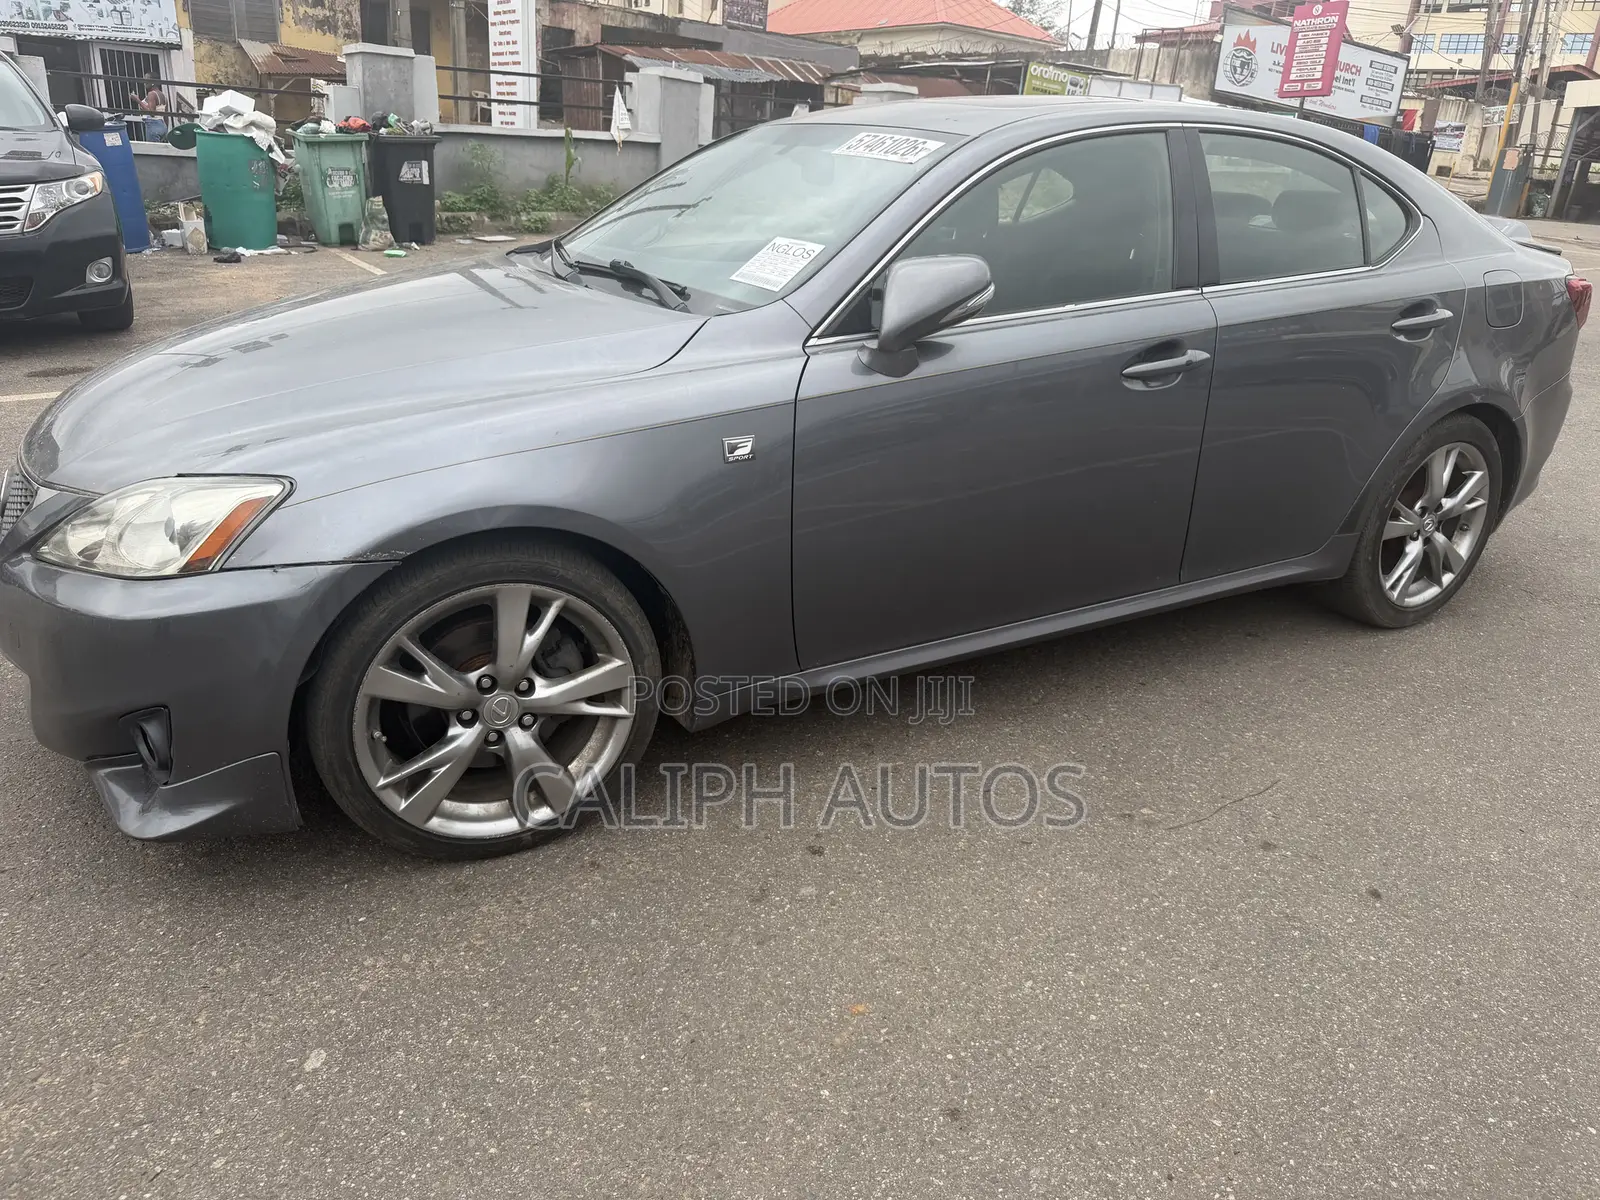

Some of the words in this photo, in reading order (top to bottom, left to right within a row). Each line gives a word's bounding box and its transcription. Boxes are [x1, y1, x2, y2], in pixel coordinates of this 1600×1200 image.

[1293, 16, 1339, 27] NATHRON
[1030, 65, 1068, 82] oraimo
[766, 242, 815, 259] NGLOS
